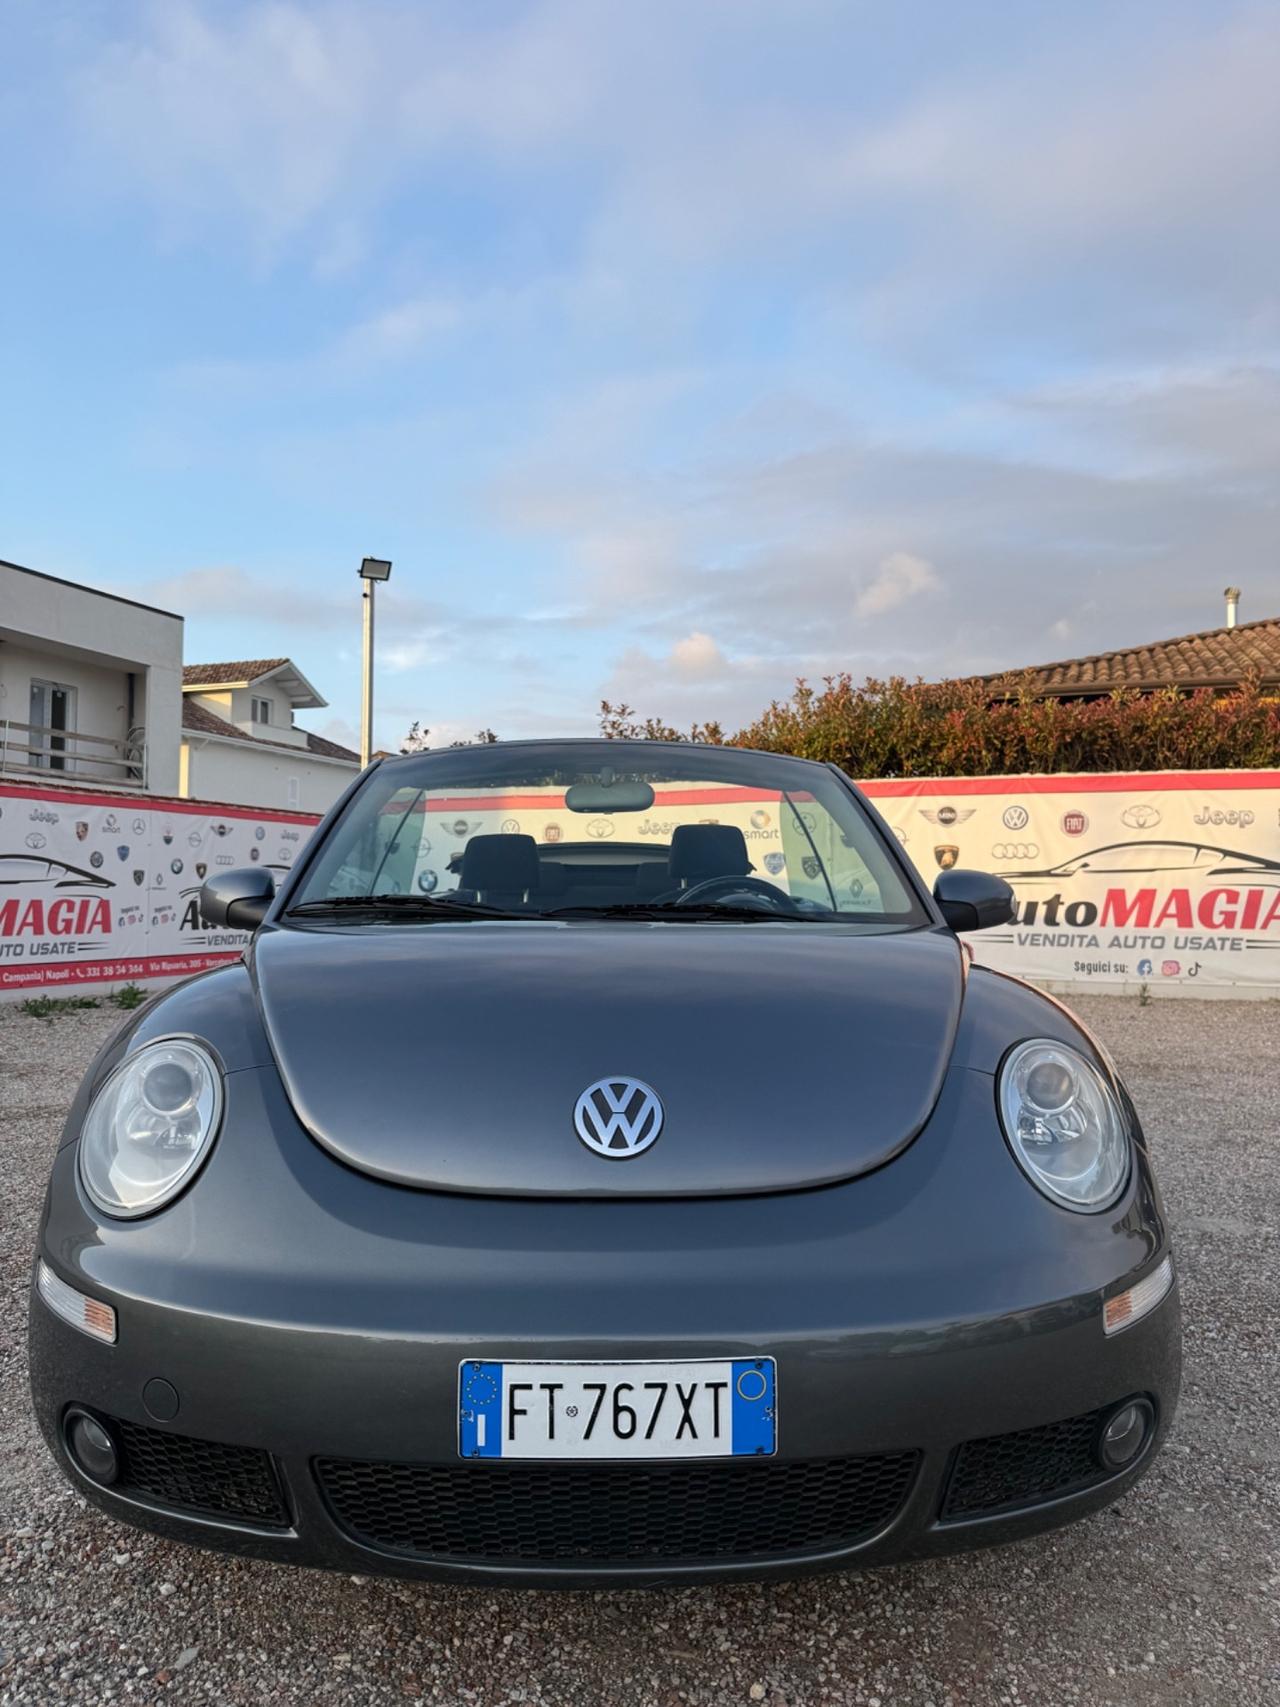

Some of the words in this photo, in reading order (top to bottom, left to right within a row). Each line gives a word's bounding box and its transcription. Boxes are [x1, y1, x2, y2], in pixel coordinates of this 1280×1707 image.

[29, 808, 59, 825] Jeep
[1193, 806, 1255, 828] Jeep
[744, 829, 780, 840] smart
[207, 934, 249, 947] VENDITA
[1017, 932, 1100, 949] VENDITA
[1108, 934, 1166, 949] AUTO
[1174, 936, 1244, 952] USATE
[30, 941, 76, 956] USATE
[46, 967, 69, 980] Napoli
[1074, 960, 1111, 975] Seguici
[1113, 964, 1129, 974] su:
